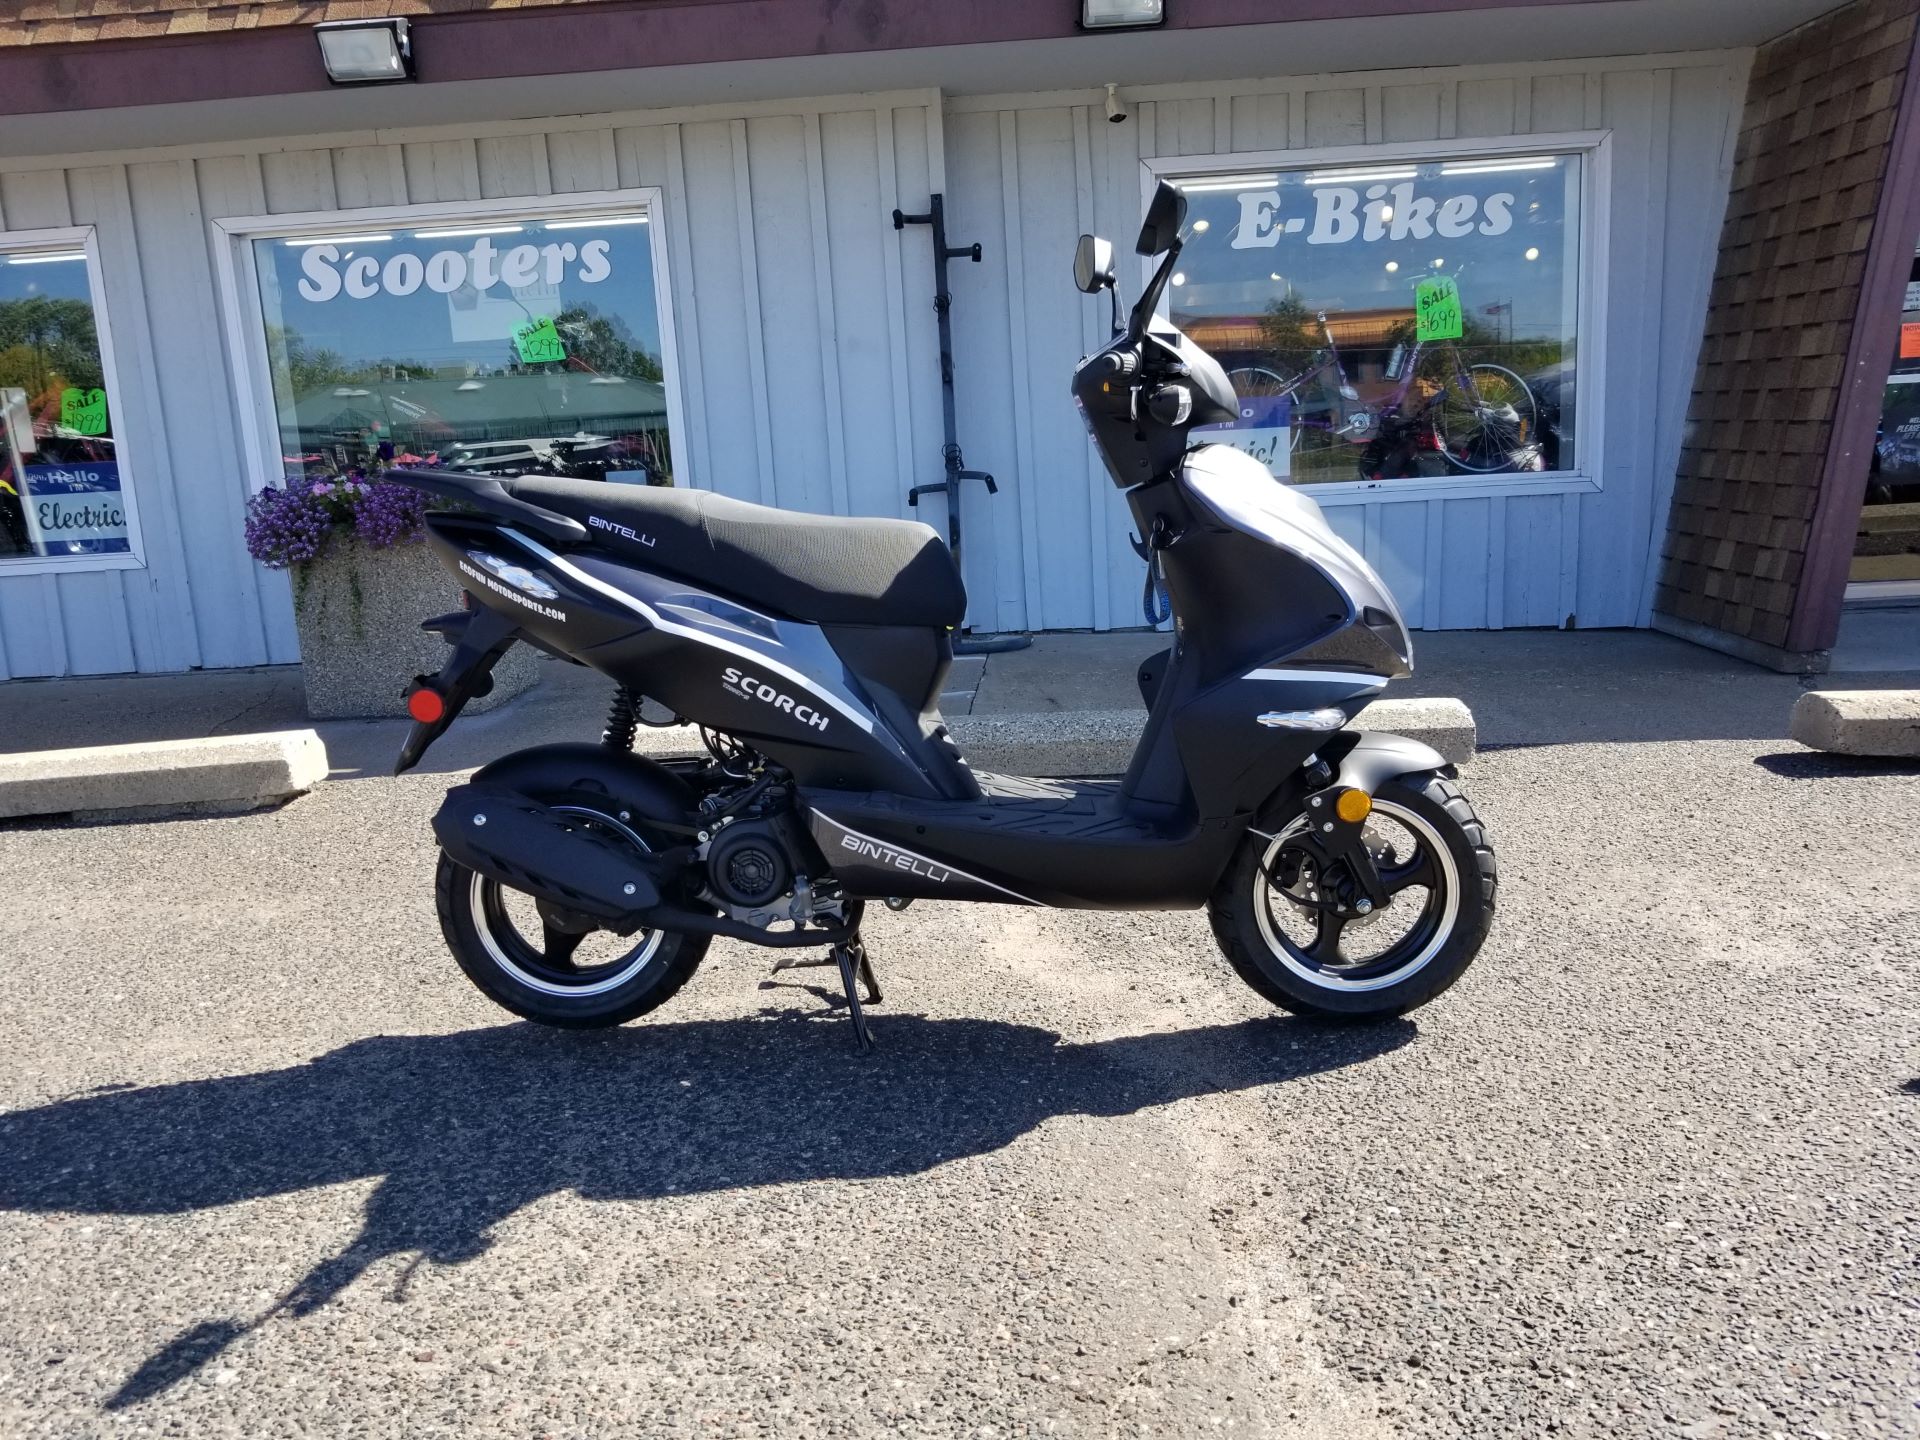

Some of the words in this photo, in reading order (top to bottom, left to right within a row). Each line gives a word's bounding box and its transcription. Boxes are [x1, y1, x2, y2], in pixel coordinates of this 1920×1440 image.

[1231, 182, 1515, 250] E-Bikes
[298, 237, 612, 302] Scooters
[1421, 281, 1454, 310] SALE
[518, 319, 549, 340] SALE
[66, 393, 100, 411] SALE
[47, 470, 100, 484] Hello
[588, 515, 656, 547] BINTELLI
[459, 560, 486, 585] ECOFUN
[487, 578, 566, 622] MOTORSPORTS.COM
[721, 667, 830, 731] SCORCH
[841, 834, 949, 882] BINTELLI
